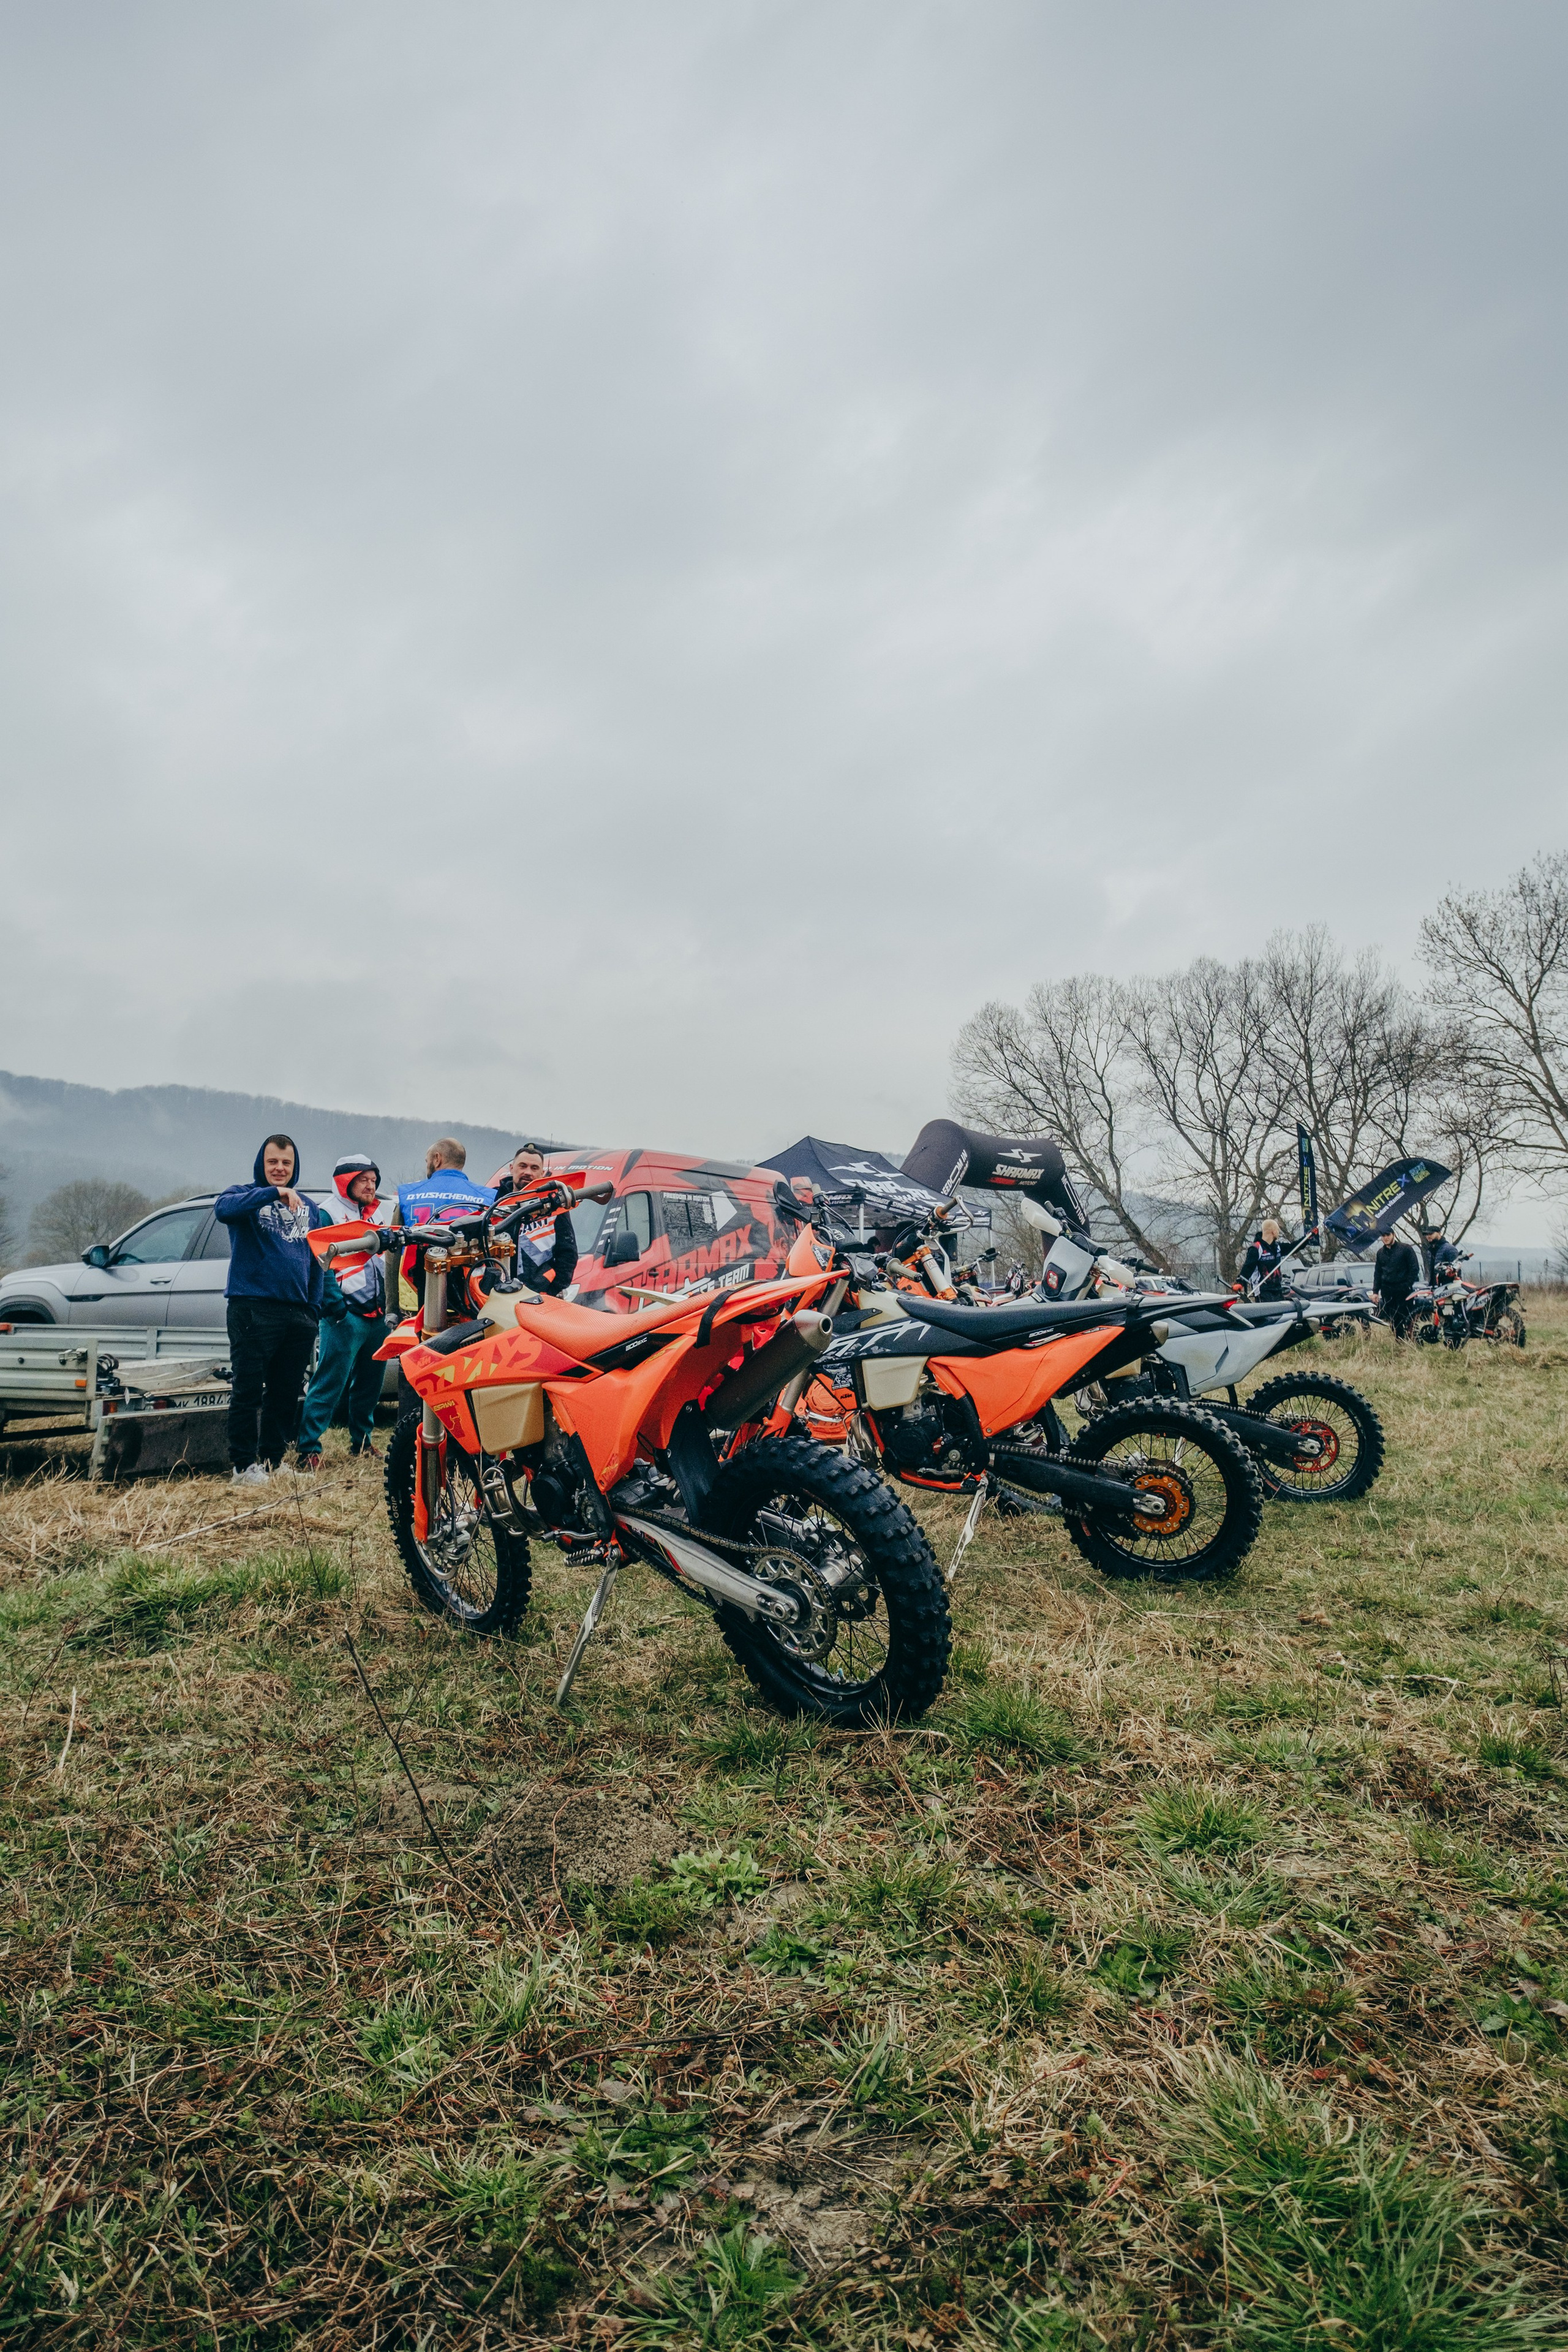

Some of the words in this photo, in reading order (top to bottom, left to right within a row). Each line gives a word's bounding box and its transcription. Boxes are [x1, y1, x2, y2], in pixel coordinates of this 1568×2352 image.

[940, 1158, 963, 1196] EEDOM
[992, 1163, 1045, 1180] SHARMAX
[406, 1192, 484, 1204] D.YUSHCHENKO
[1365, 1173, 1410, 1215] NITREX
[718, 1263, 750, 1288] TEAM
